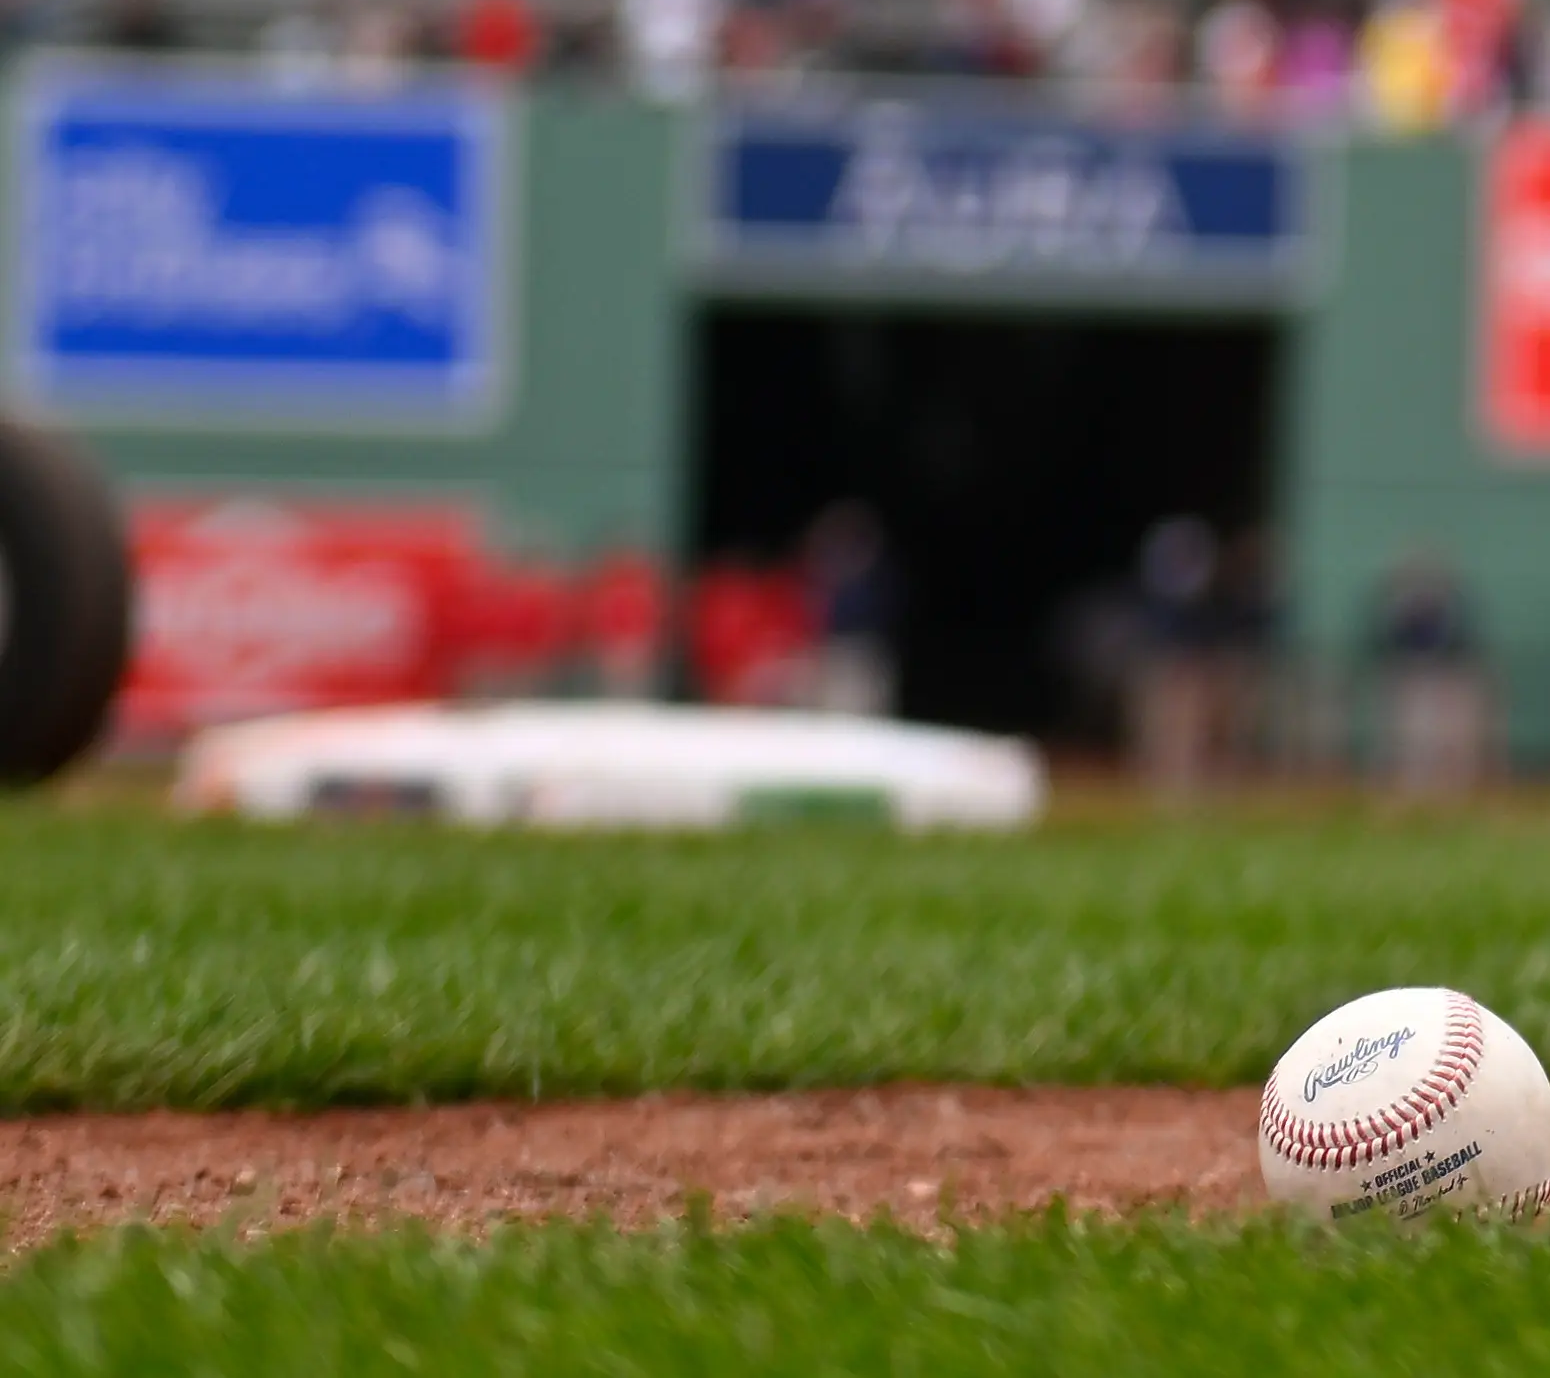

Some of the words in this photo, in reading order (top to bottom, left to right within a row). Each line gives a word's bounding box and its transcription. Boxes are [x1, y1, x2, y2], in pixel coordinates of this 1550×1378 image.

[1303, 1026, 1416, 1102] Rawlings
[1374, 1157, 1423, 1188] OFFICIAL
[1376, 1175, 1421, 1205] LEAGUE
[1421, 1140, 1483, 1185] BASEBALL
